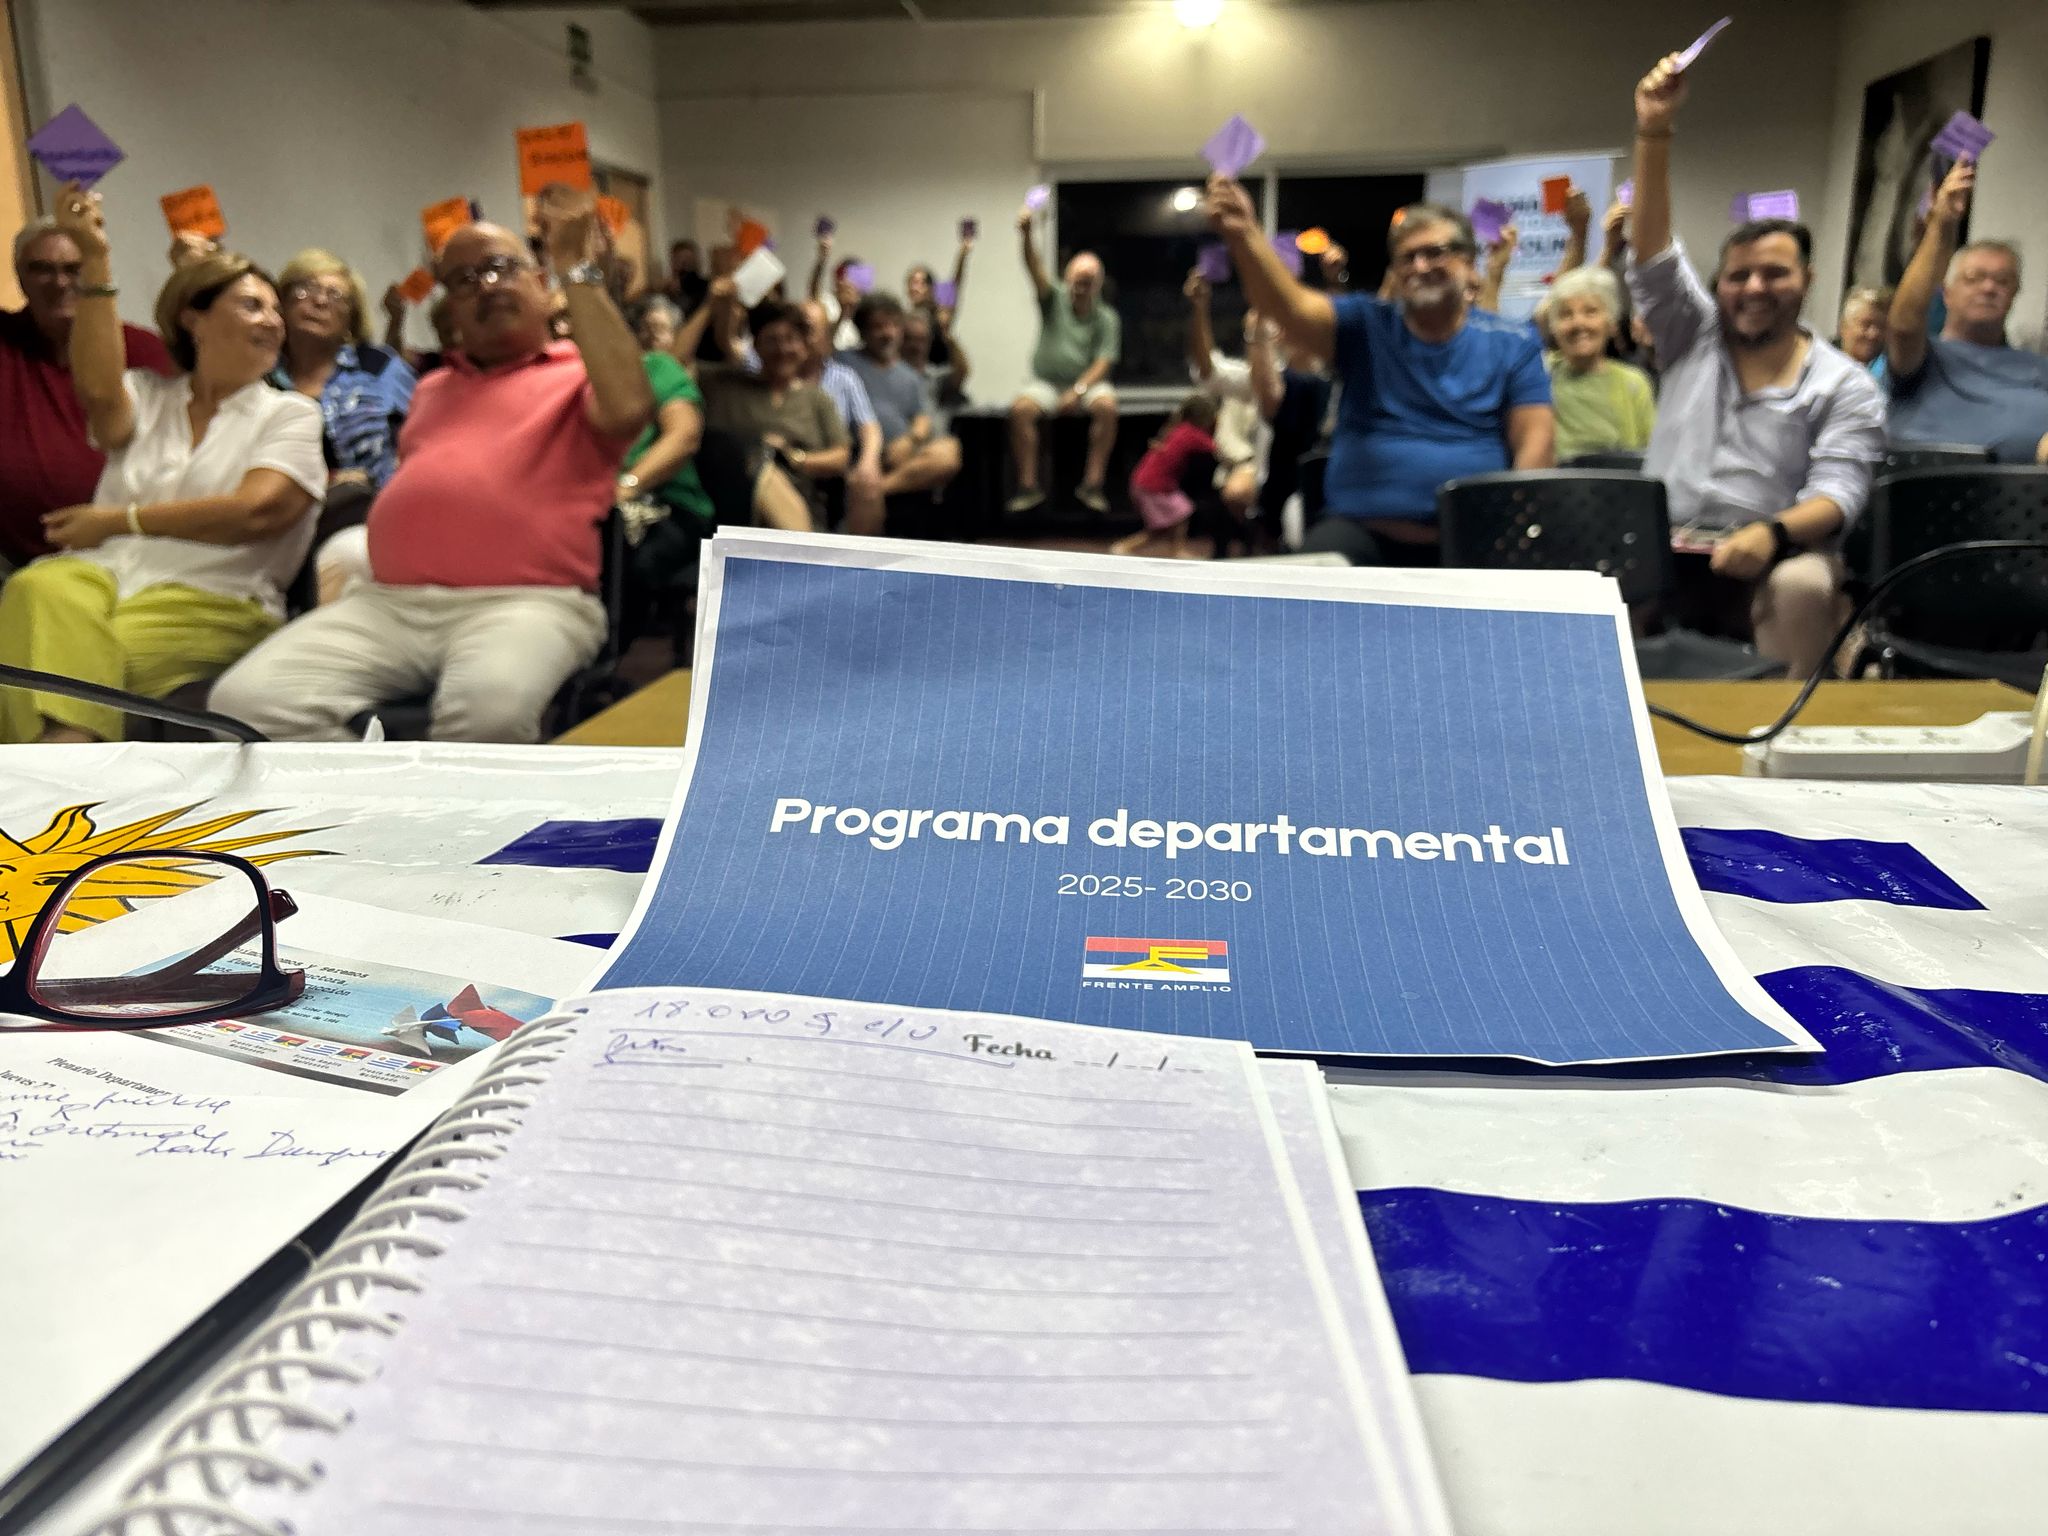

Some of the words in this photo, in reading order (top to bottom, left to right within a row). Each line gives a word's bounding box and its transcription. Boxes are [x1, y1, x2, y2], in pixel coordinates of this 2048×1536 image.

[770, 797, 1070, 851] Programa
[1087, 808, 1570, 866] departamental
[1057, 873, 1157, 898] 2025-
[1165, 878, 1252, 902] 2030
[319, 966, 370, 979] seremos
[1082, 980, 1154, 991] FRENTE
[1159, 983, 1232, 993] AMPLIO
[962, 1033, 1057, 1062] Fecha
[45, 1056, 98, 1076] Plenario
